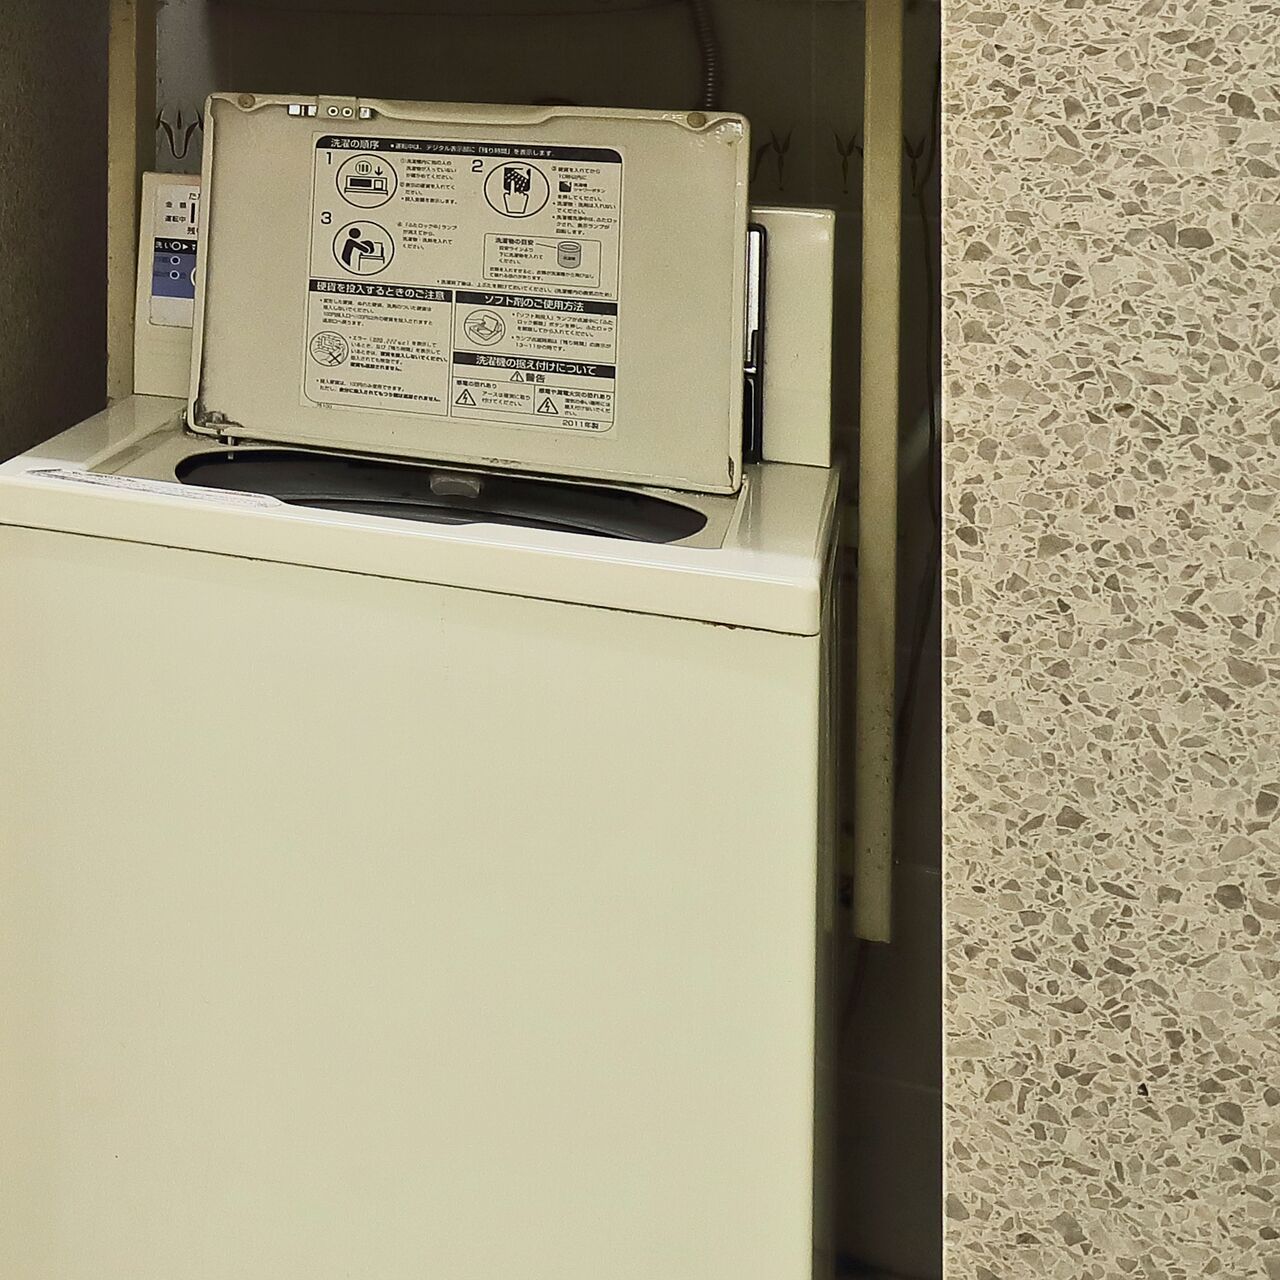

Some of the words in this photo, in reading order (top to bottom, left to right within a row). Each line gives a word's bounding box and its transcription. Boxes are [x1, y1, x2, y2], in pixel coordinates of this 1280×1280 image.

[326, 151, 332, 165] 1
[471, 159, 484, 173] 2
[320, 211, 332, 225] 3
[484, 294, 585, 312] ソフト剤のご使用方法
